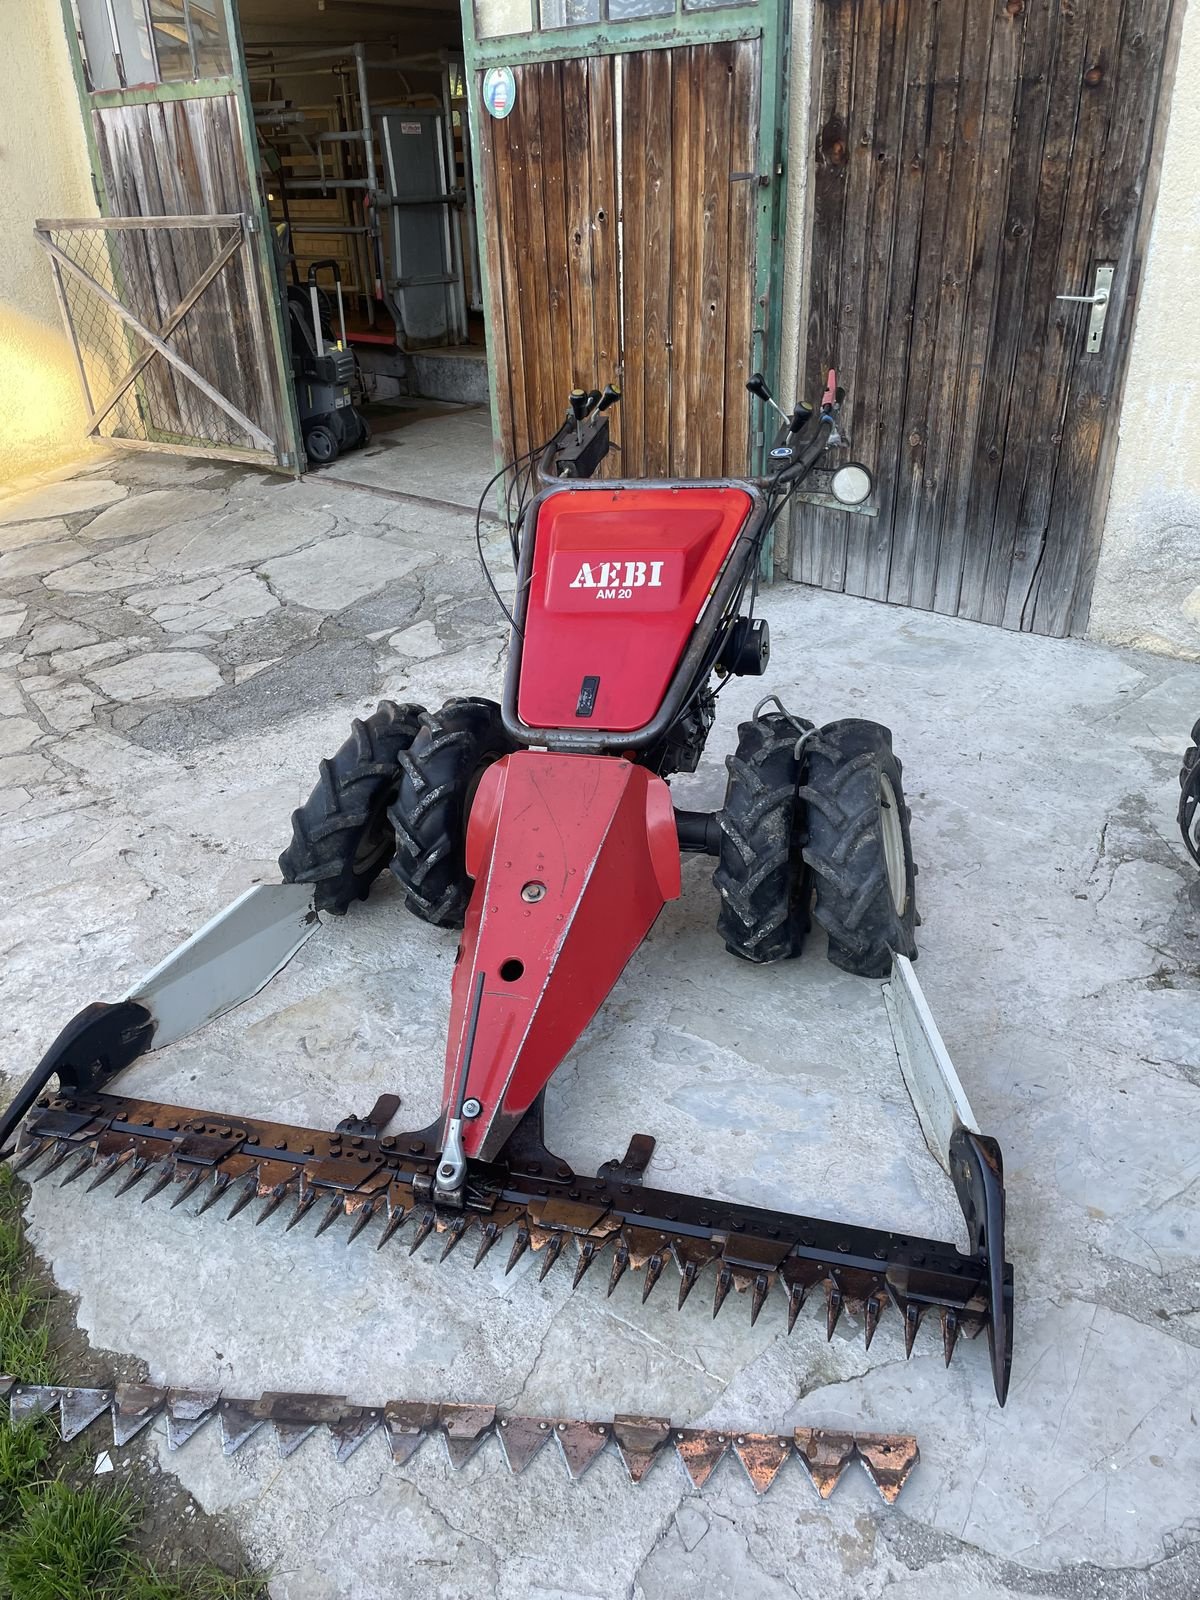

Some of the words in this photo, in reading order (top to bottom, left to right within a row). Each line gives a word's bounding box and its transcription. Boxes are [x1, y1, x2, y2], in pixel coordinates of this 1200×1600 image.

[569, 561, 664, 588] AEBI
[596, 589, 616, 599] AM
[618, 588, 632, 599] 20
